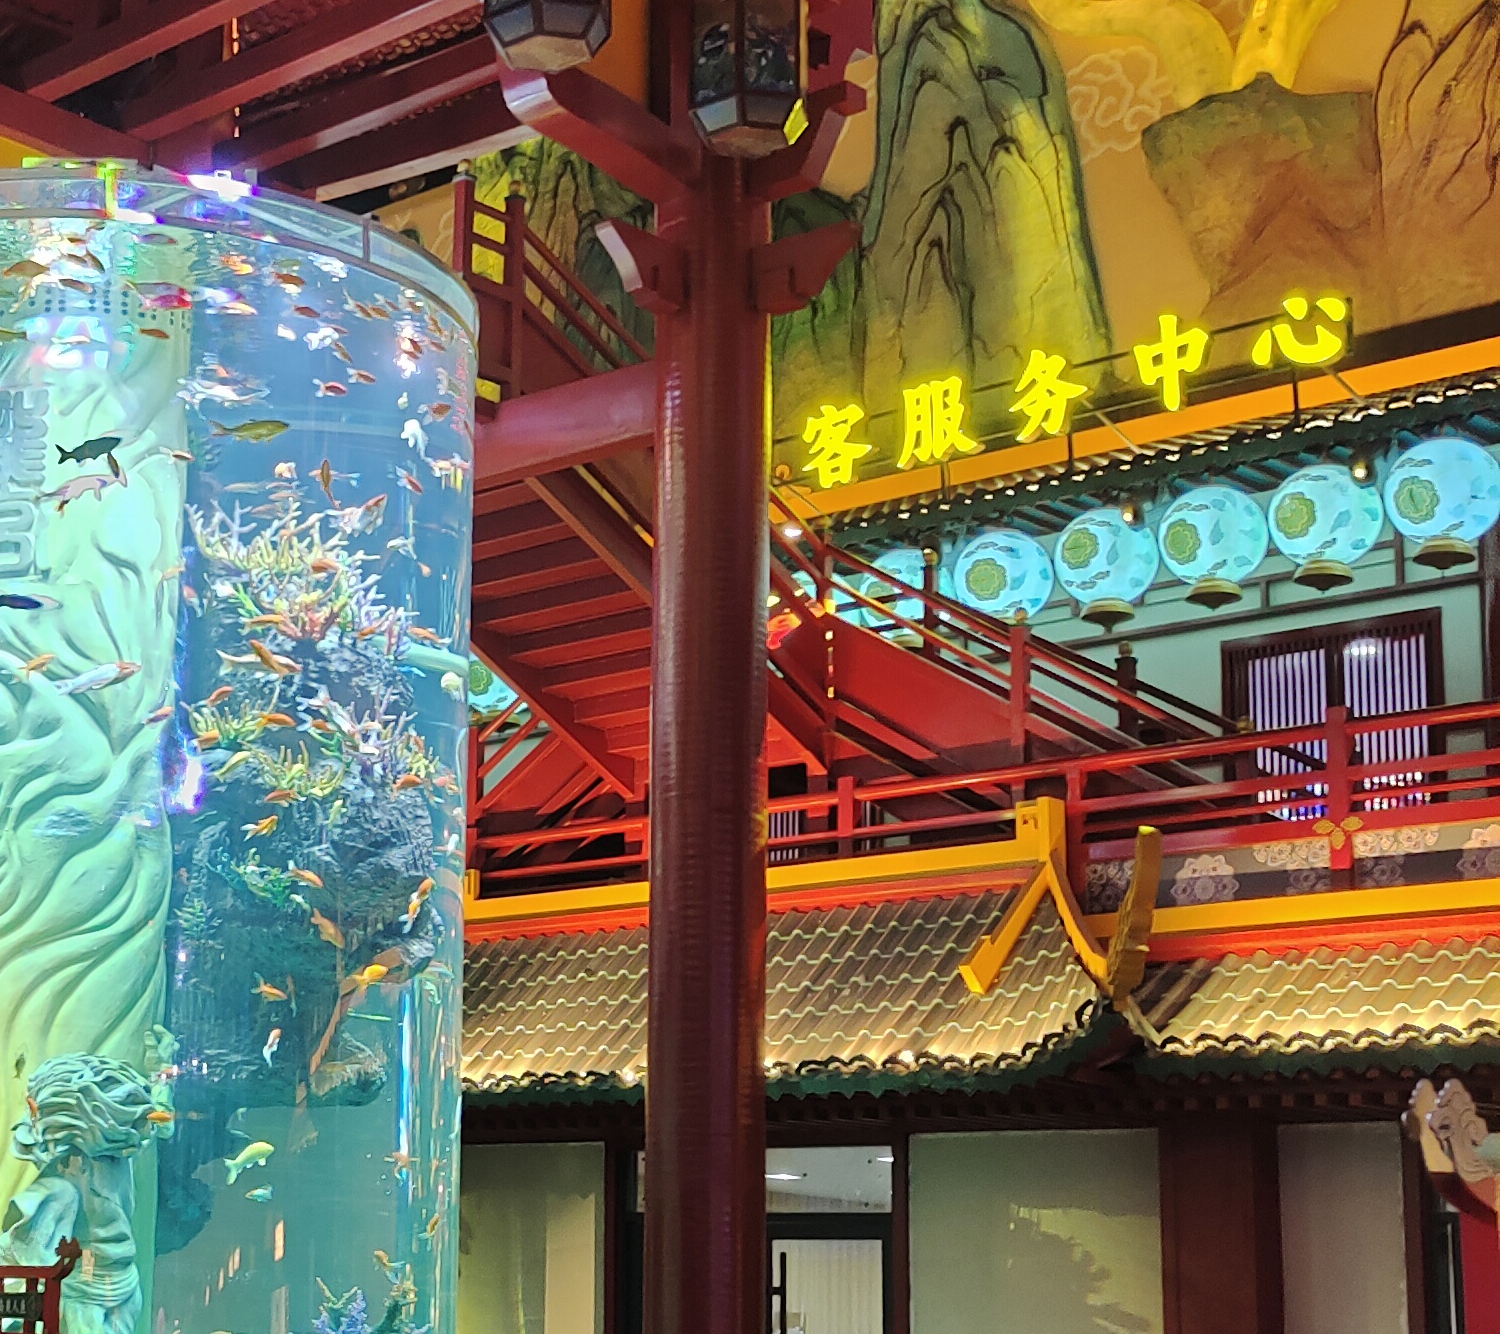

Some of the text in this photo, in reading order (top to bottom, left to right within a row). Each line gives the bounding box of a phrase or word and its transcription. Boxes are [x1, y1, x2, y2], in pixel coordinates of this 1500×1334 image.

[802, 296, 1346, 489] 客服务中心
